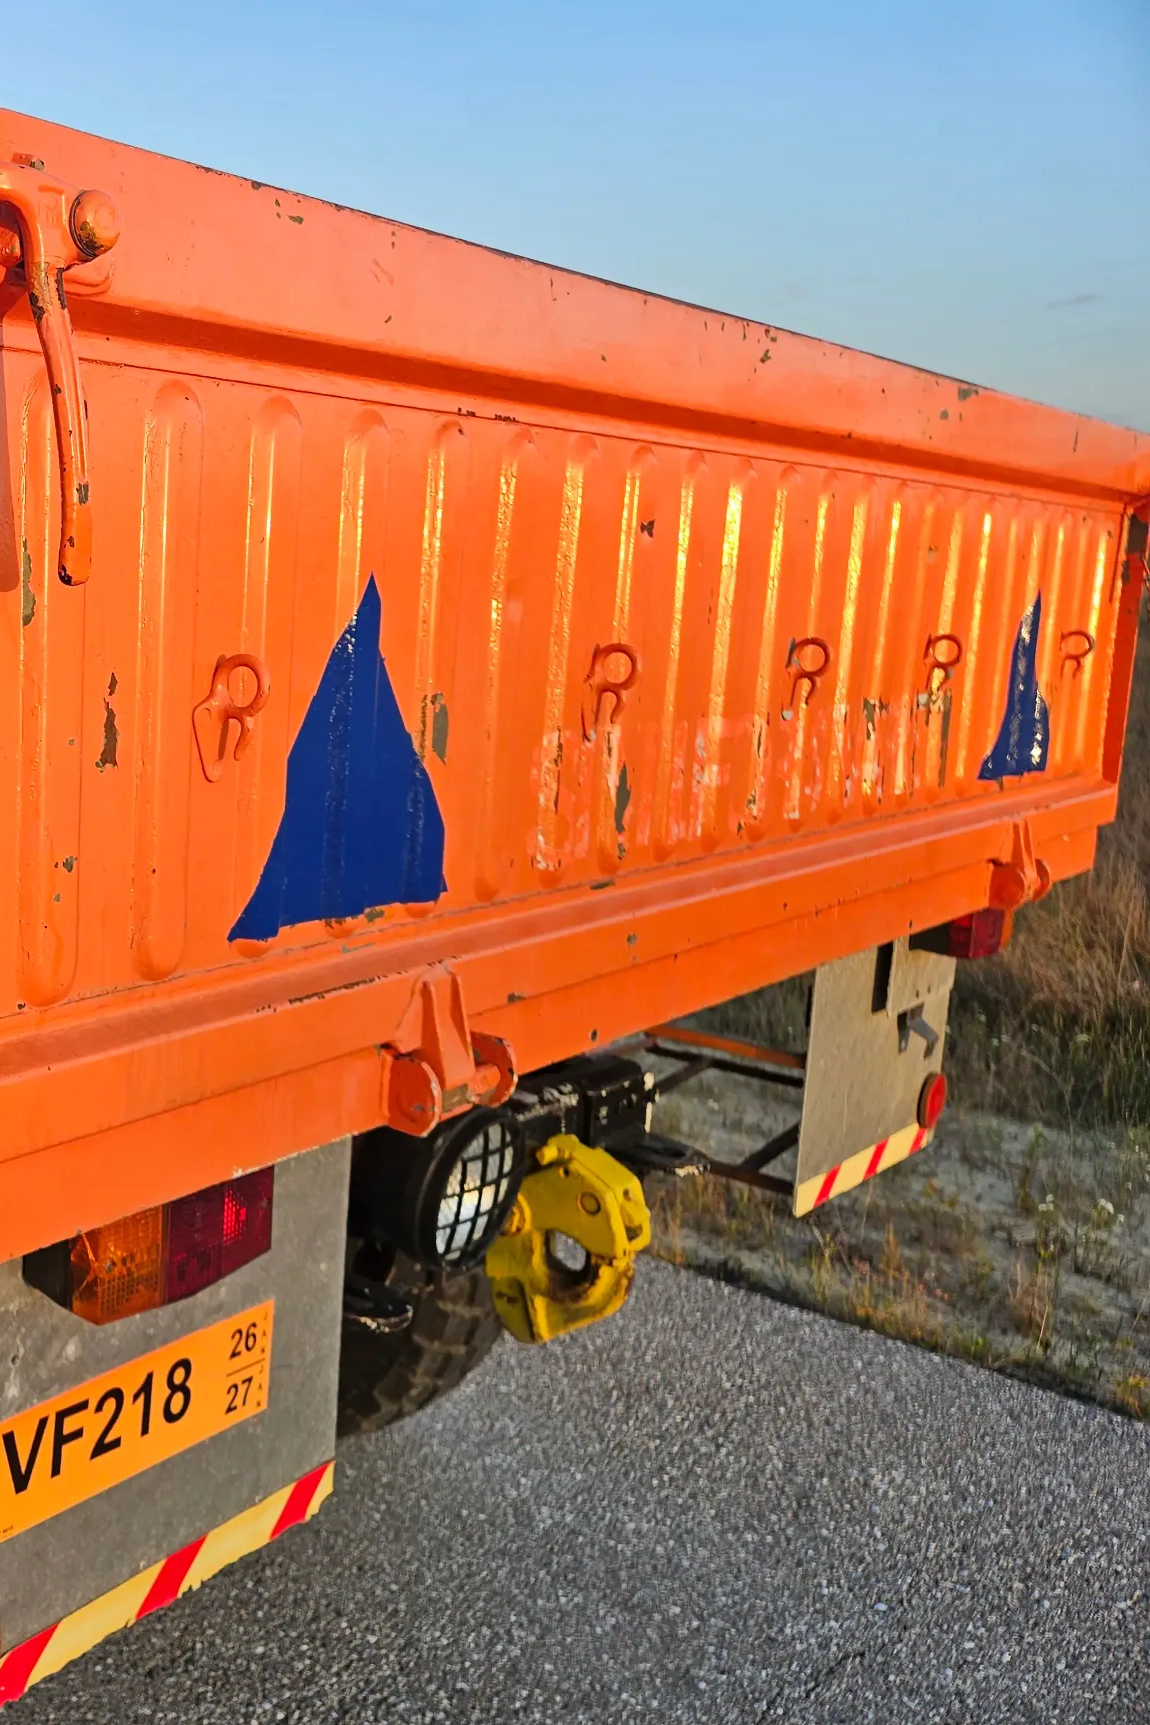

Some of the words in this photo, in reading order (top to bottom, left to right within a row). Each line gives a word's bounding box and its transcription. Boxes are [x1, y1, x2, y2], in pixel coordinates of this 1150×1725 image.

[228, 1322, 257, 1360] 26
[225, 1376, 254, 1415] 27
[2, 1358, 192, 1495] VF218
